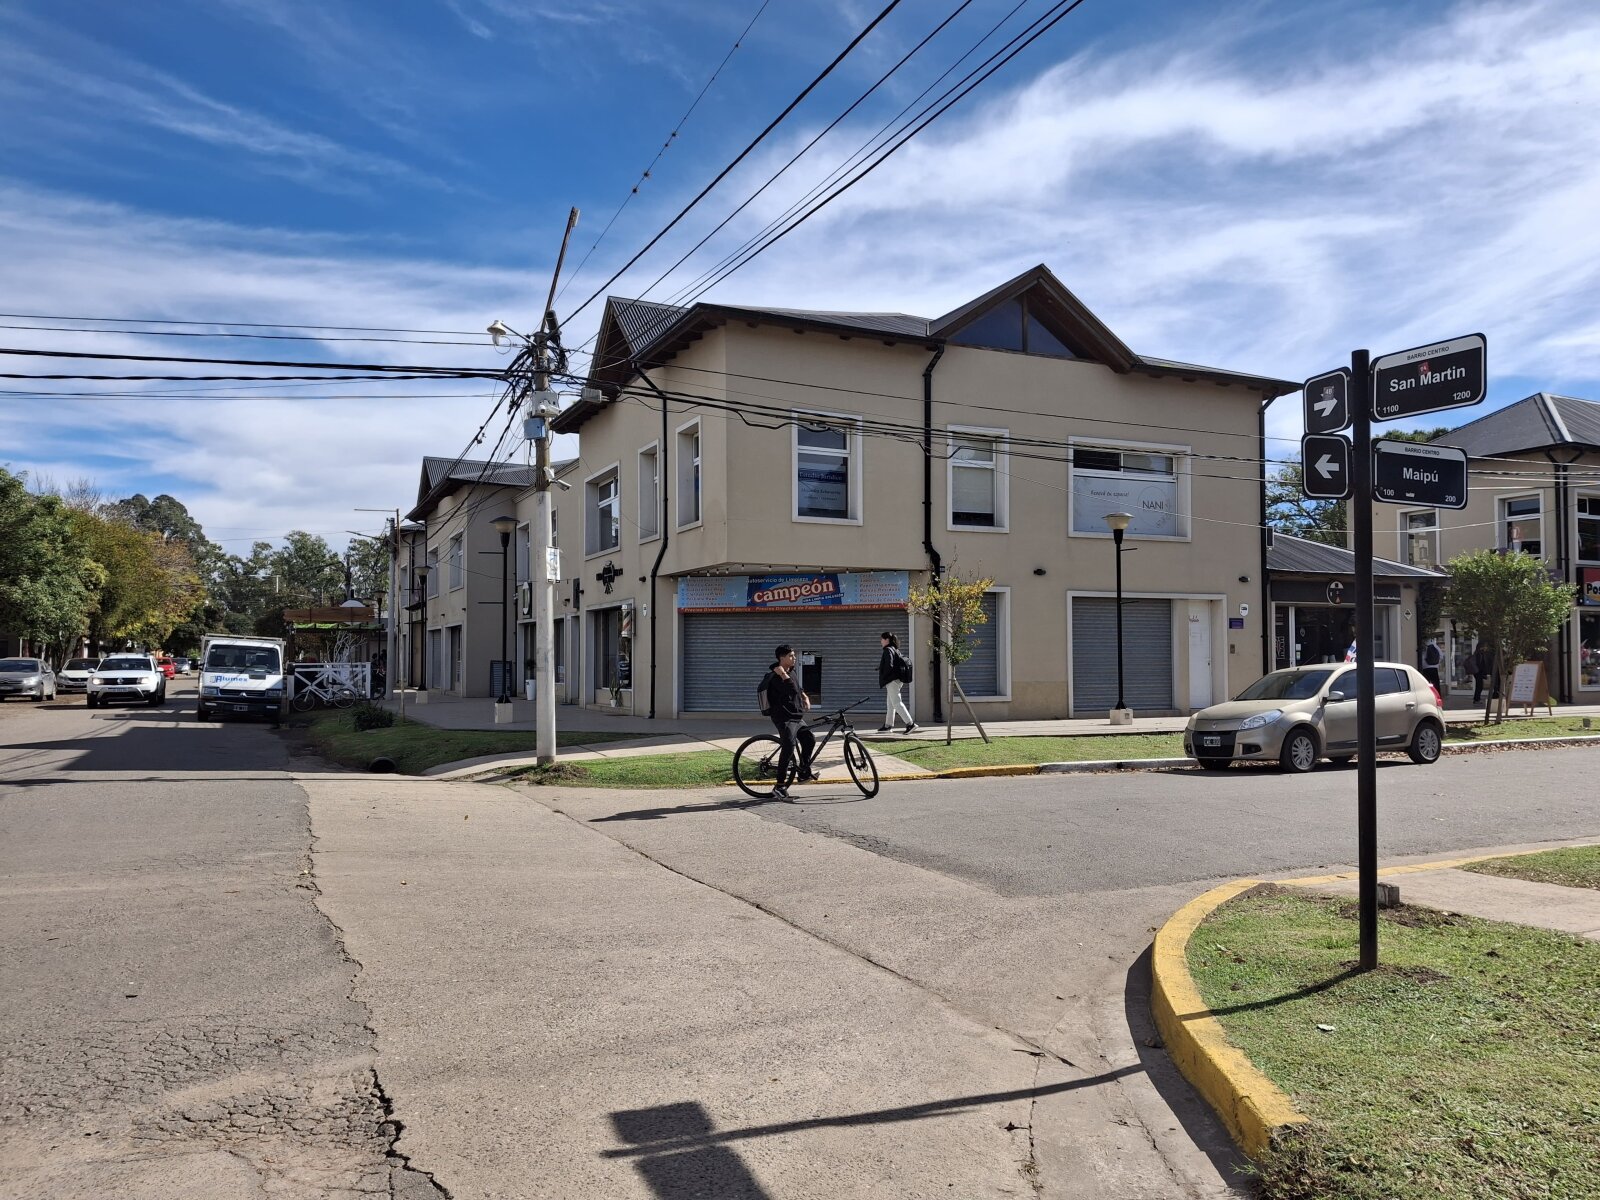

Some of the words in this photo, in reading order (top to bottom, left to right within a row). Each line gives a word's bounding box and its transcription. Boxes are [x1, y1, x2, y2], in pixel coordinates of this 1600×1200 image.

[1406, 351, 1427, 361] BARRIO
[1427, 346, 1450, 356] CENTRO
[1389, 378, 1416, 392] San
[1453, 390, 1471, 400] 1200
[1382, 404, 1399, 414] 1100
[1403, 467, 1439, 484] Maipú
[1383, 488, 1395, 496] 100
[1444, 495, 1457, 503] 200
[1142, 500, 1164, 510] NANI
[753, 578, 834, 603] campeón
